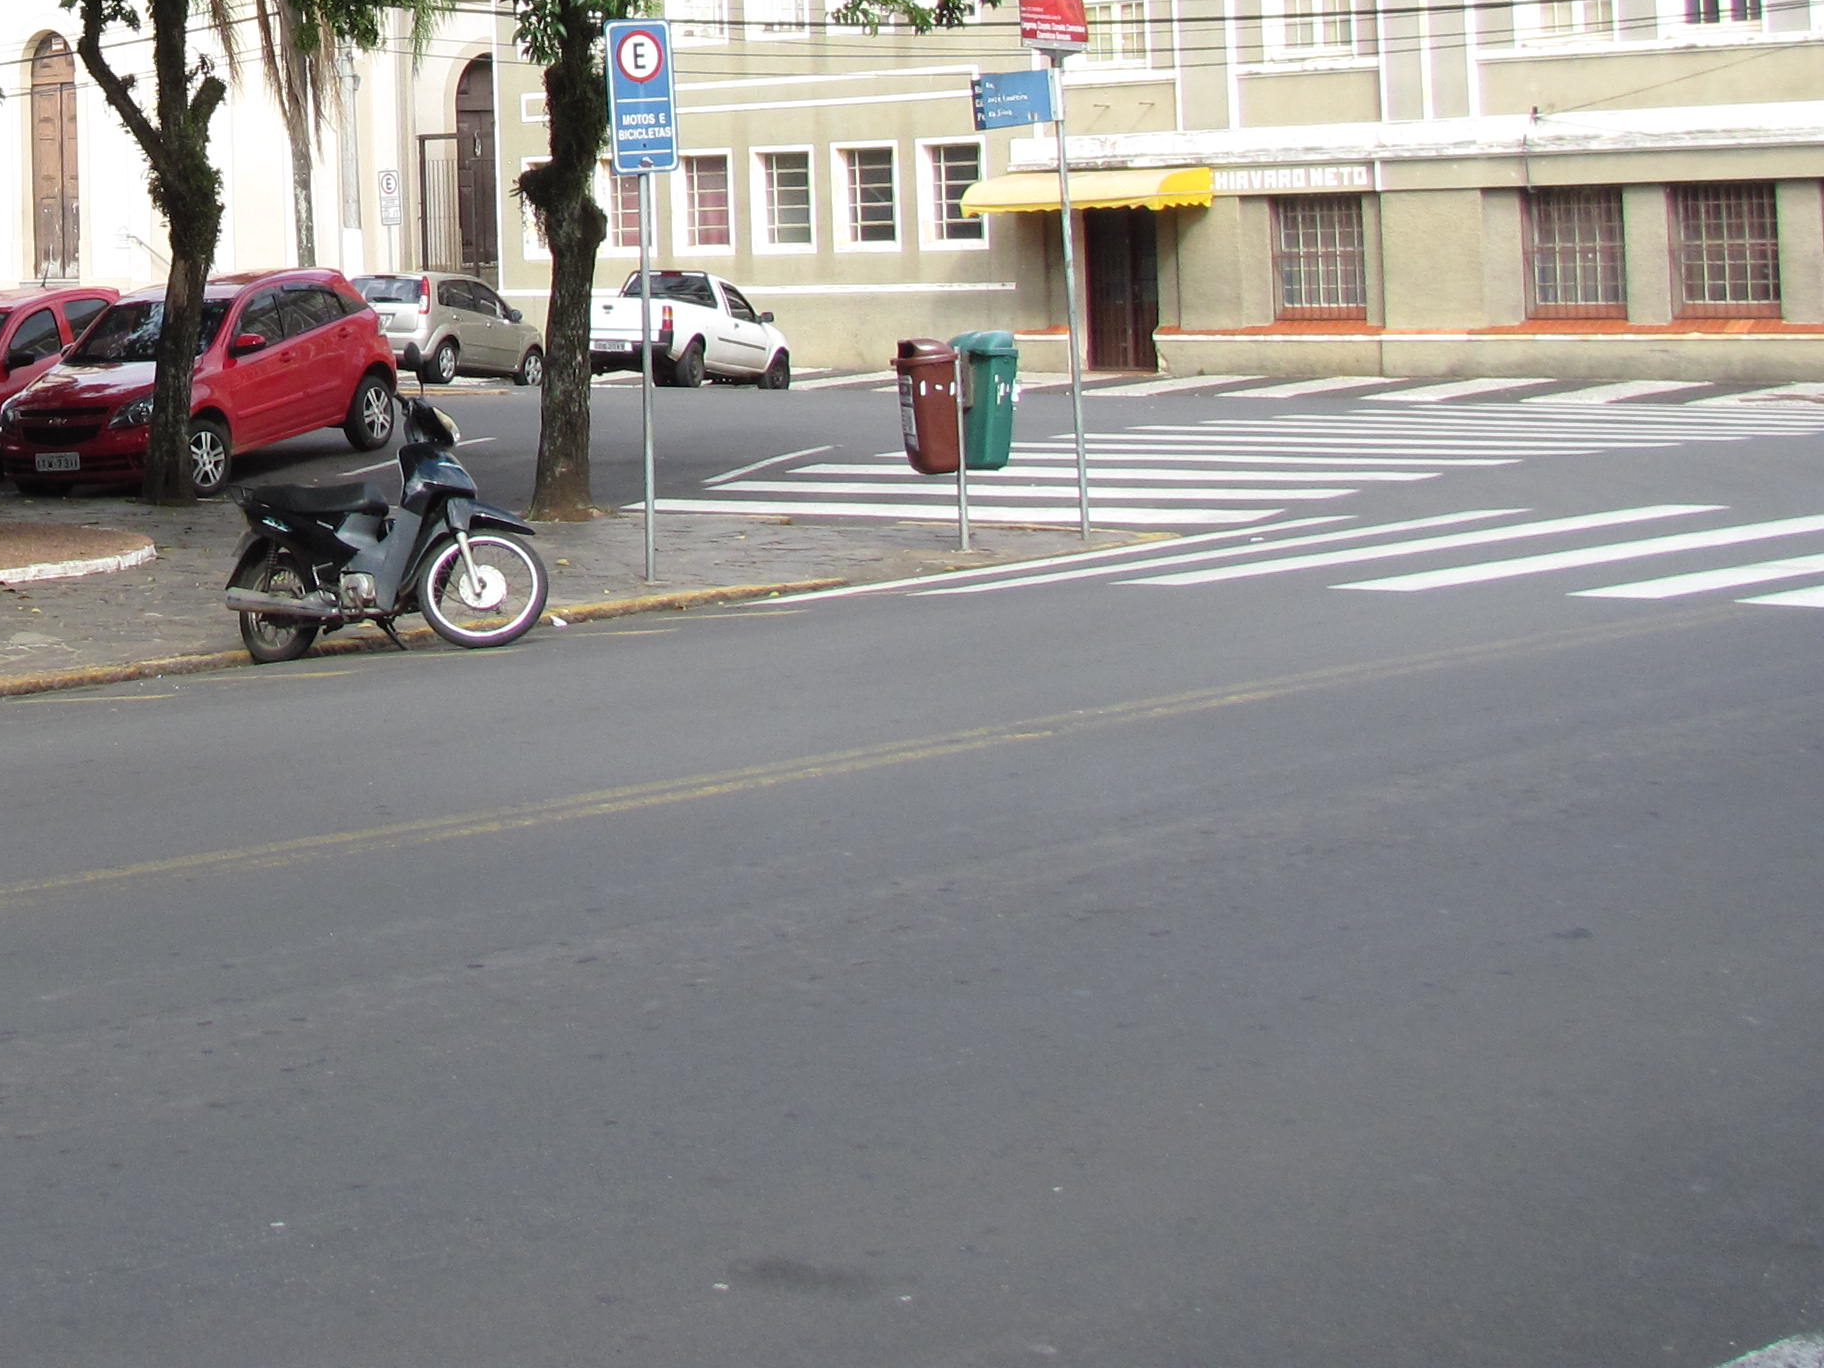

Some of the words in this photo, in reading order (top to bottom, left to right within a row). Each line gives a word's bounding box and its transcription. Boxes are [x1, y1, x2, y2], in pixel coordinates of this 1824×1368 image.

[633, 42, 646, 70] E
[622, 113, 656, 126] MOTOS
[659, 112, 666, 124] E
[618, 126, 672, 141] BICICLETAS
[385, 177, 392, 190] E
[1309, 166, 1368, 186] NETO
